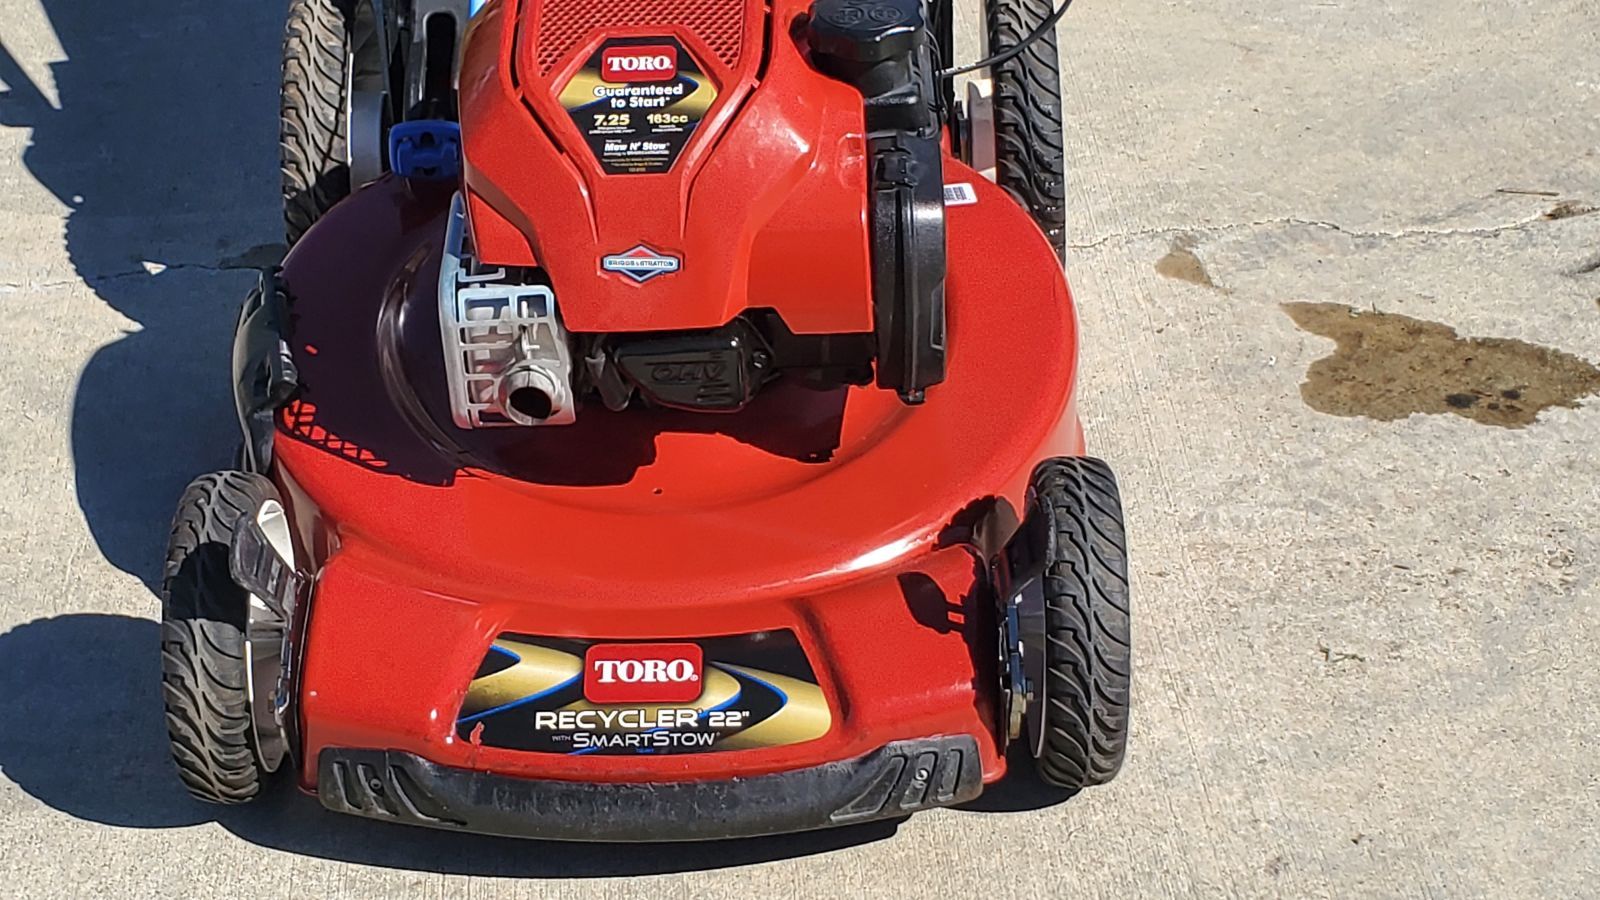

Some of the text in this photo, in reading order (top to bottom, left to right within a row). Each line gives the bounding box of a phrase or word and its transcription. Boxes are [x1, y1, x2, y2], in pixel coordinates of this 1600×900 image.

[607, 56, 671, 71] TORO
[593, 84, 683, 97] Guaranteed
[611, 97, 628, 108] to
[593, 114, 630, 126] 7.25
[646, 113, 689, 125] 163cc
[594, 659, 697, 684] TORO
[535, 709, 698, 730] RECYCLER
[572, 731, 715, 748] SMARTSTOW
